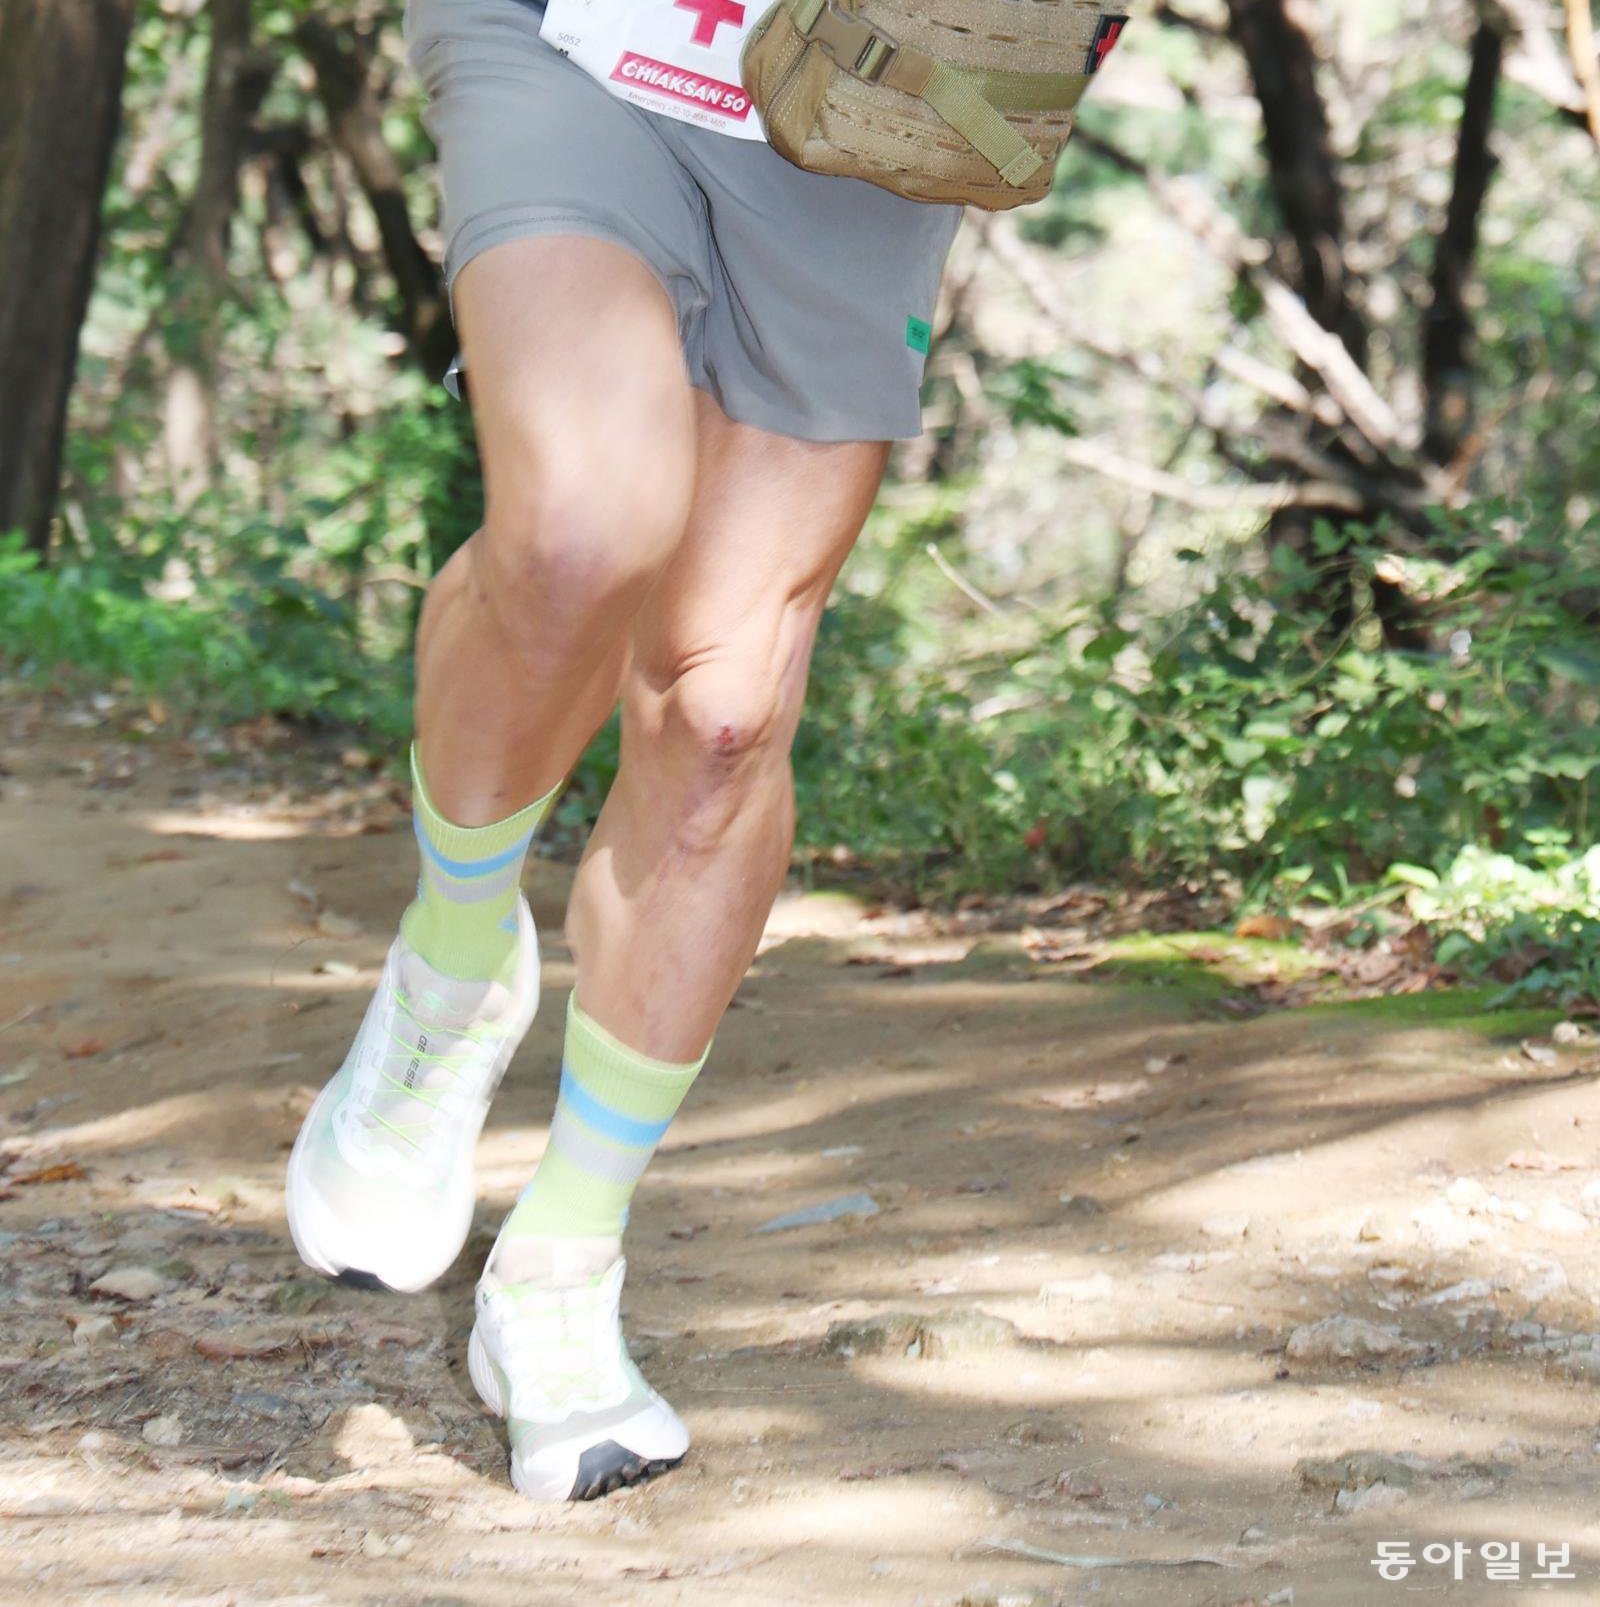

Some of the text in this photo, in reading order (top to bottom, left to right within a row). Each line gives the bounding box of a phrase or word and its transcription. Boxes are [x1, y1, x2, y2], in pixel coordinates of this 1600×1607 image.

[557, 32, 582, 47] 5052
[621, 61, 746, 112] CHIAKSAN 50
